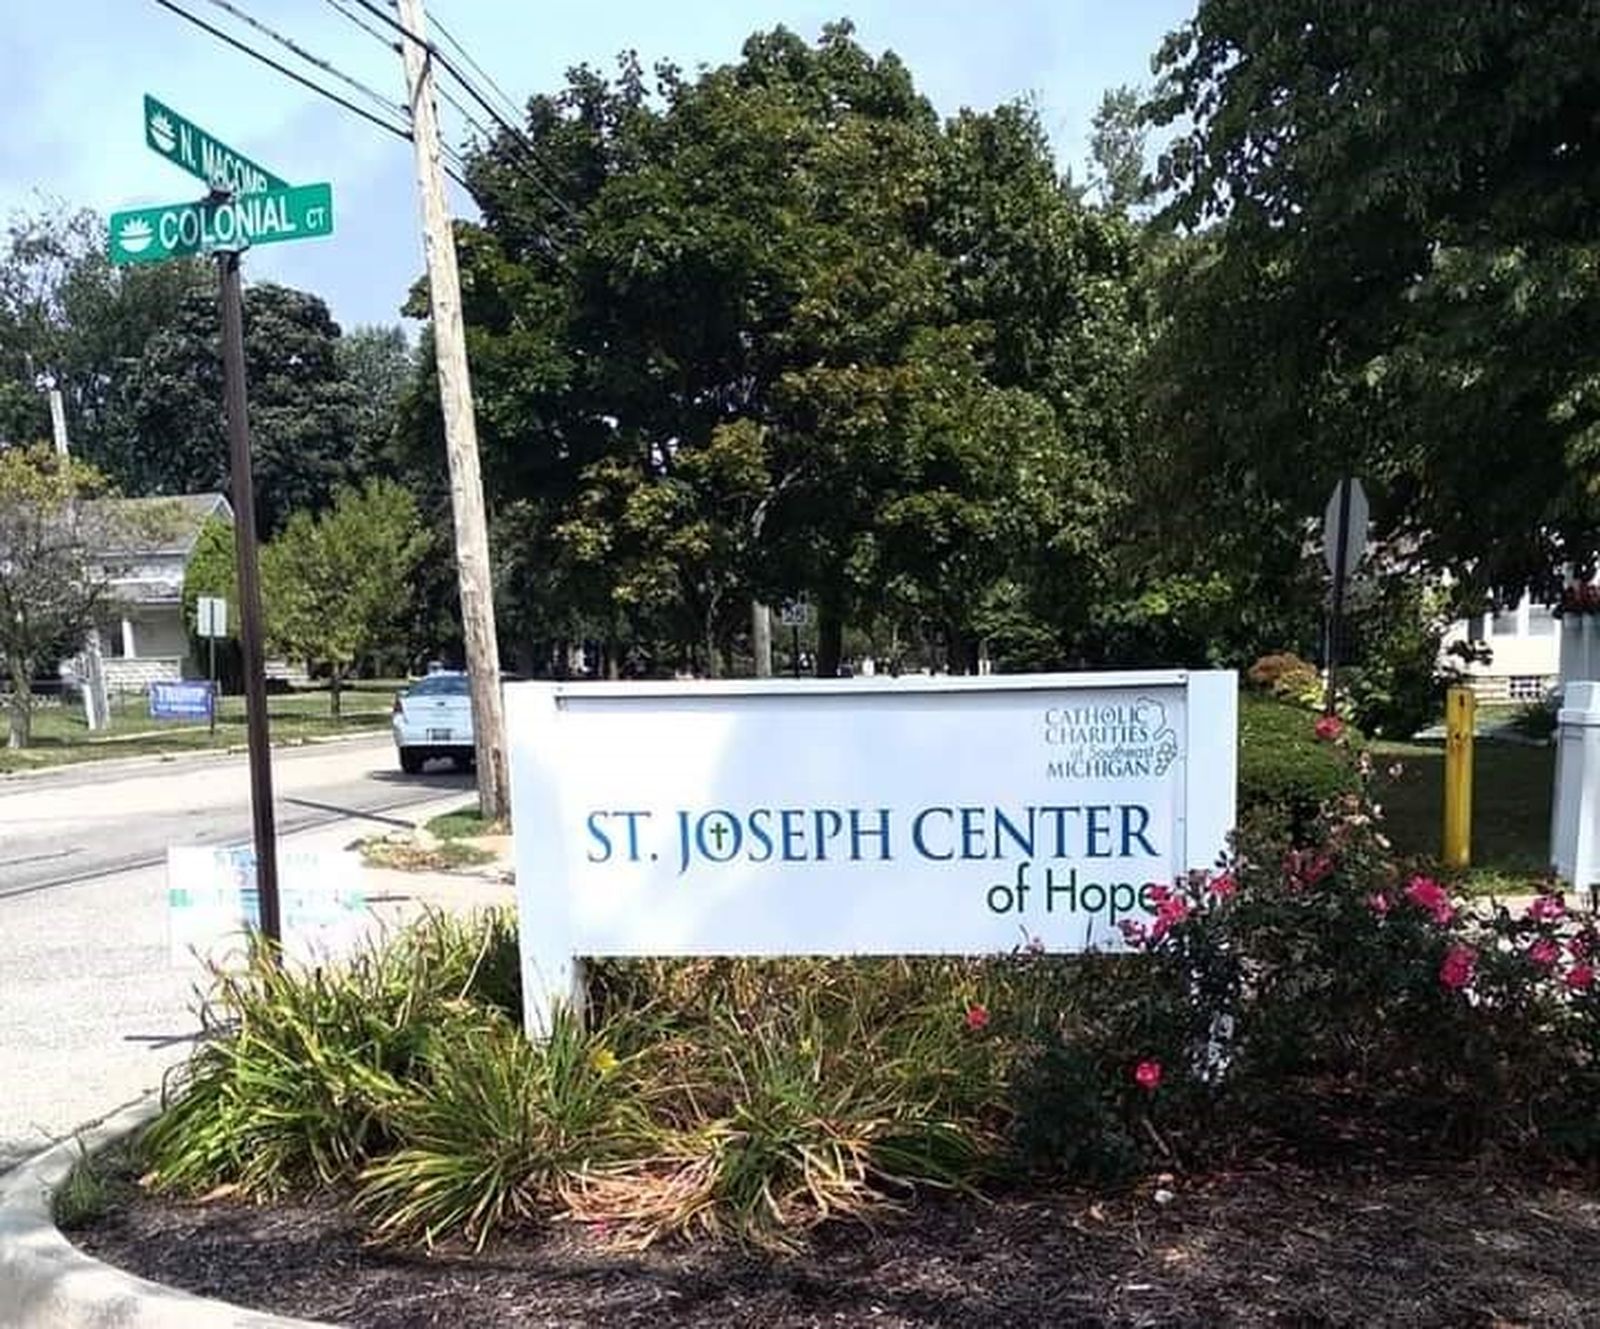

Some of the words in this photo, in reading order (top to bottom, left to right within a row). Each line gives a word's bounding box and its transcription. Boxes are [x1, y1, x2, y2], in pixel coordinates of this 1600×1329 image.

[179, 124, 197, 167] N.
[201, 138, 268, 197] MACOMB
[159, 196, 296, 249] COLONIAL
[306, 206, 324, 229] CT
[1045, 705, 1149, 725] CATHOLIC
[1045, 727, 1149, 744] CHARITIES
[1048, 760, 1150, 777] MICHIGAN
[587, 809, 658, 863] ST.
[677, 808, 890, 875] JOSEPH
[912, 804, 1160, 861] CENTER
[987, 861, 1030, 913] of
